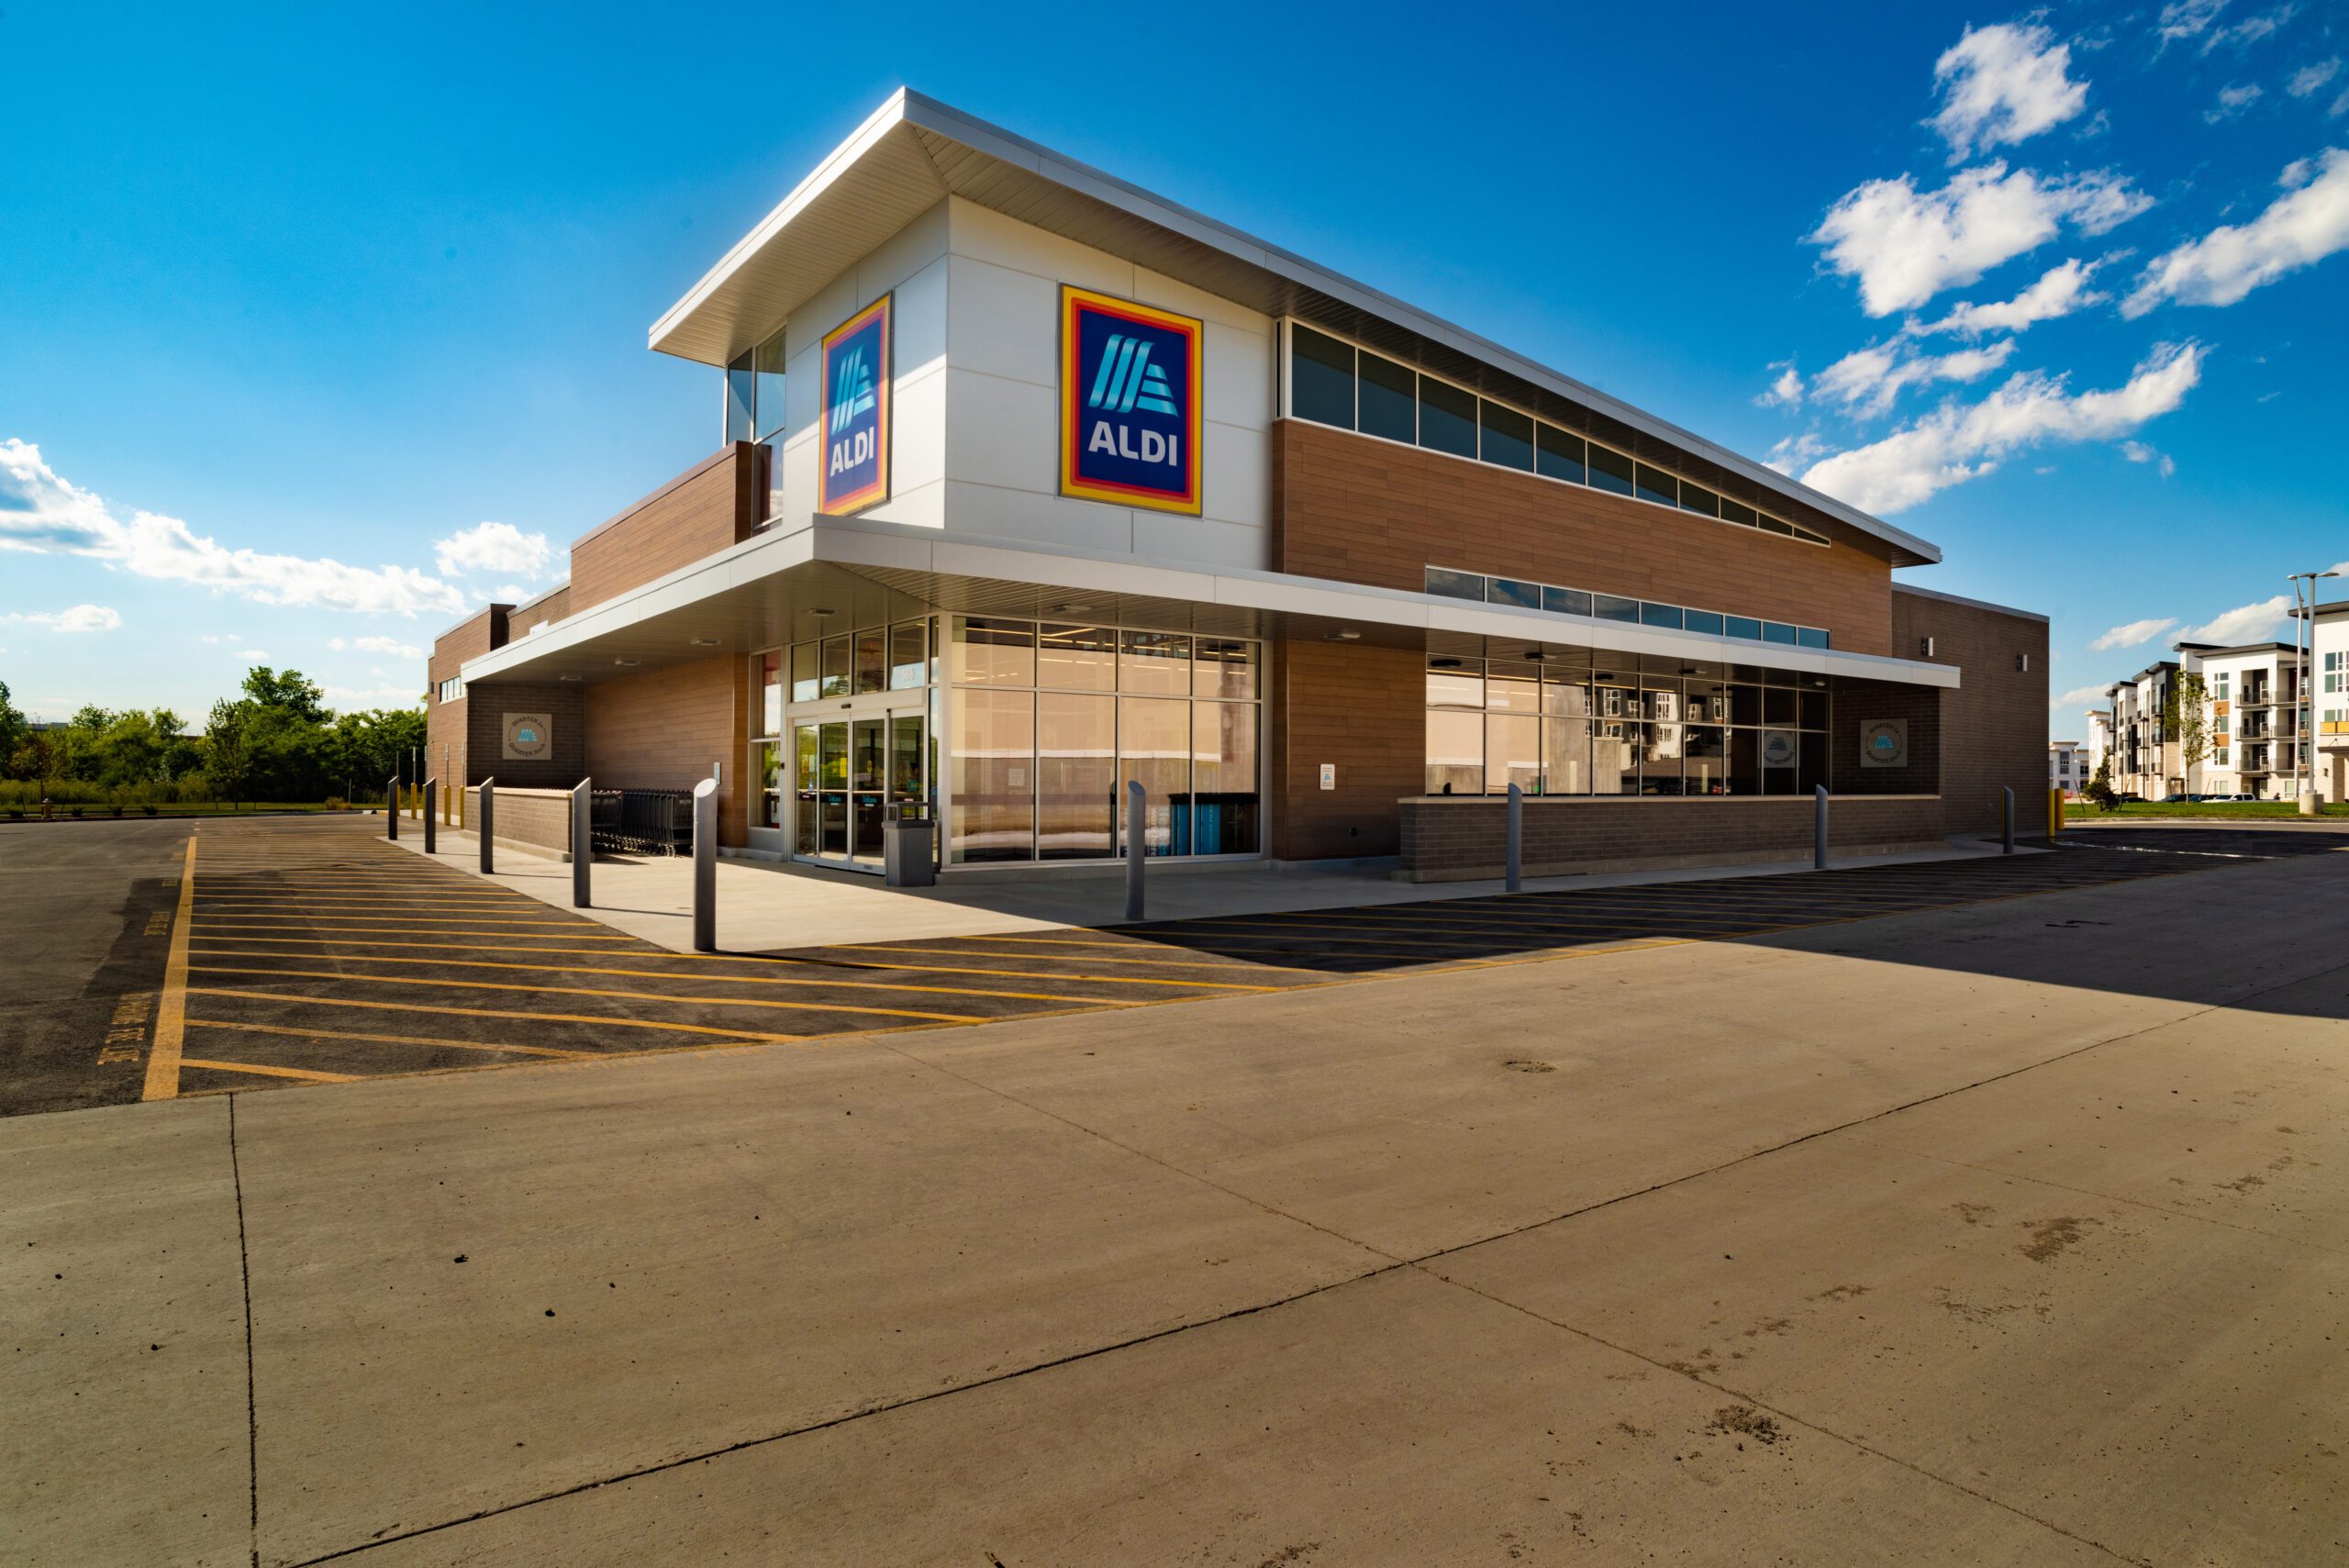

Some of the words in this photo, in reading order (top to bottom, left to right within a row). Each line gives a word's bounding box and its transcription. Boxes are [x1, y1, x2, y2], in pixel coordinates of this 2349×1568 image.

[829, 426, 874, 477] ALDI
[1088, 420, 1177, 467] ALDI
[511, 716, 538, 727] QUARTER
[509, 742, 534, 757] QUARTER
